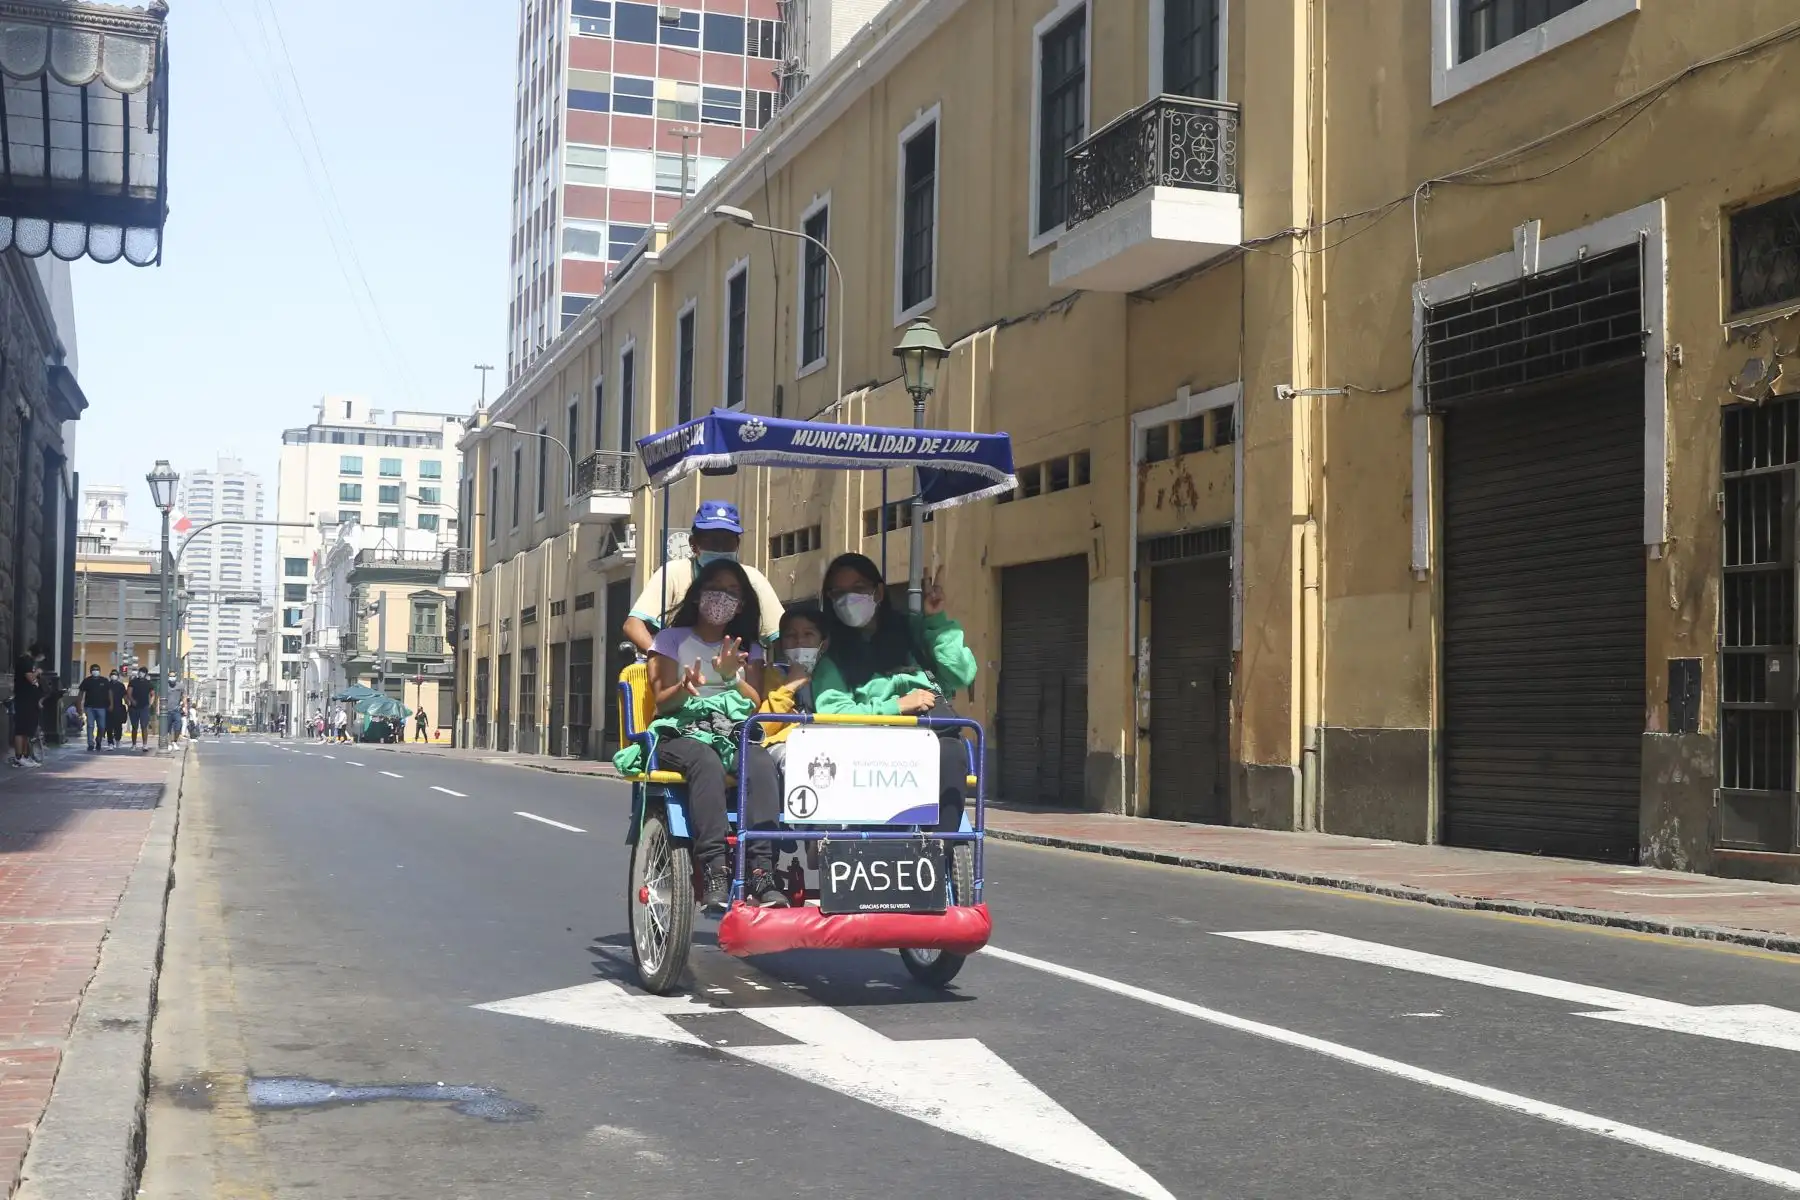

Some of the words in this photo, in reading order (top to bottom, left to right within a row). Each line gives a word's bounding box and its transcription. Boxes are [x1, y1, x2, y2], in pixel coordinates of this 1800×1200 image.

[790, 429, 917, 454] MUNICIPALIDAD
[917, 438, 942, 454] DE
[940, 438, 980, 454] LIMA
[852, 769, 919, 788] LIMA
[796, 789, 808, 815] 1
[830, 857, 936, 894] PASEO
